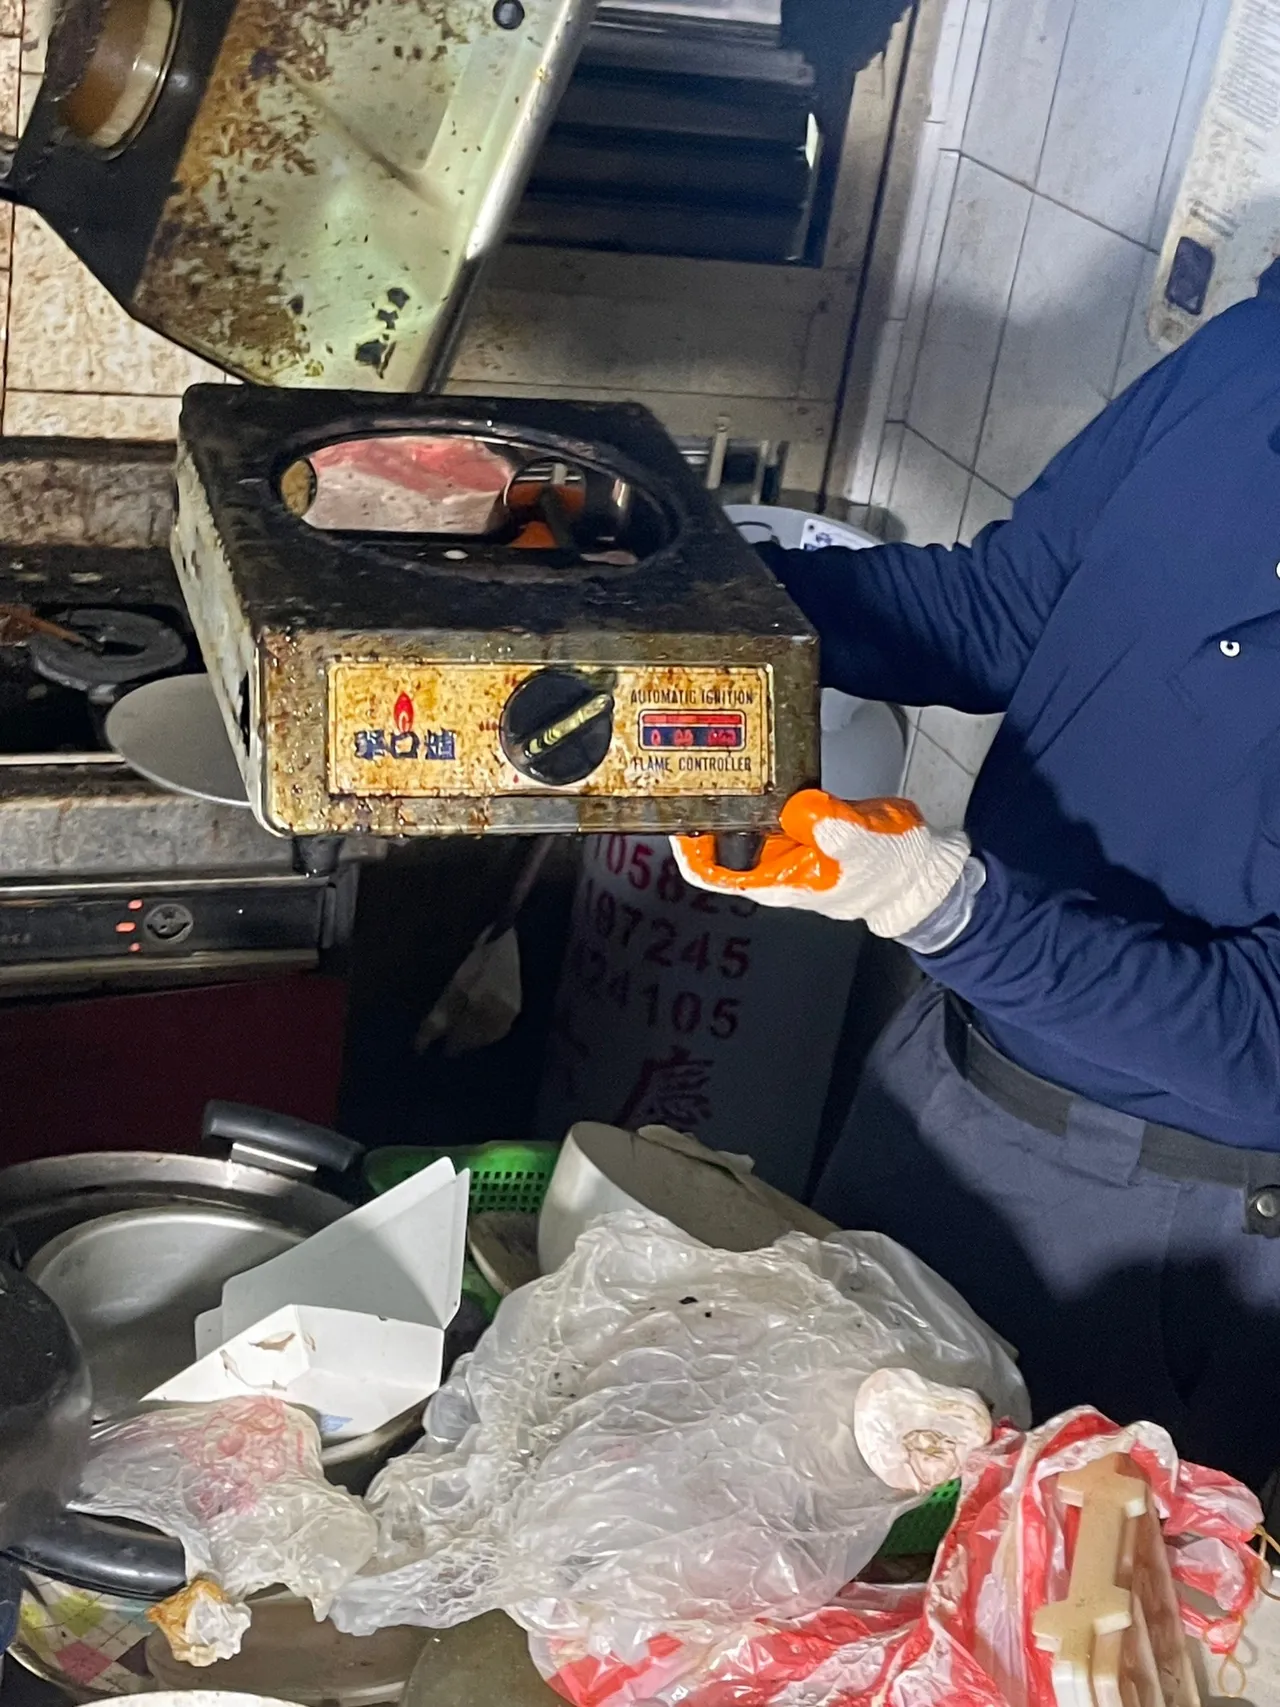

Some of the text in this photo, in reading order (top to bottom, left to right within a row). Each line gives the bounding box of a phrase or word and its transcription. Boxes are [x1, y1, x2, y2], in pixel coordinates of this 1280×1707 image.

[631, 689, 754, 704] AUTOMATIC IGNITION
[633, 757, 752, 772] FLAME CONTROLLER
